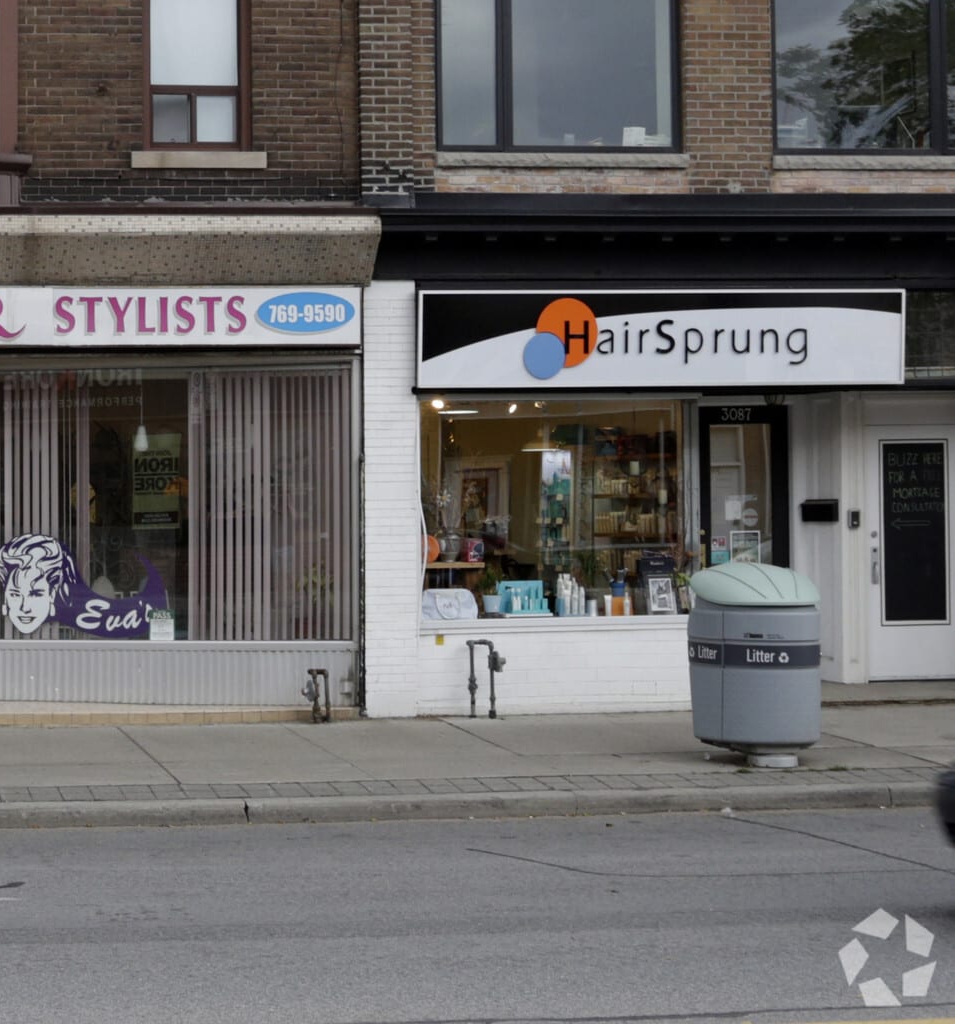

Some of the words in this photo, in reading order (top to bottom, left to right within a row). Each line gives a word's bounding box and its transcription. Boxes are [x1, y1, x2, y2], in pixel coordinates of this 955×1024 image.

[54, 295, 248, 335] STYLISTS
[268, 303, 346, 324] 769-9590
[563, 319, 809, 366] HairSprung
[720, 407, 752, 422] 3087
[886, 452, 919, 467] BUZZ
[909, 469, 918, 481] A
[697, 644, 718, 660] Litter
[745, 647, 776, 663] Litter
